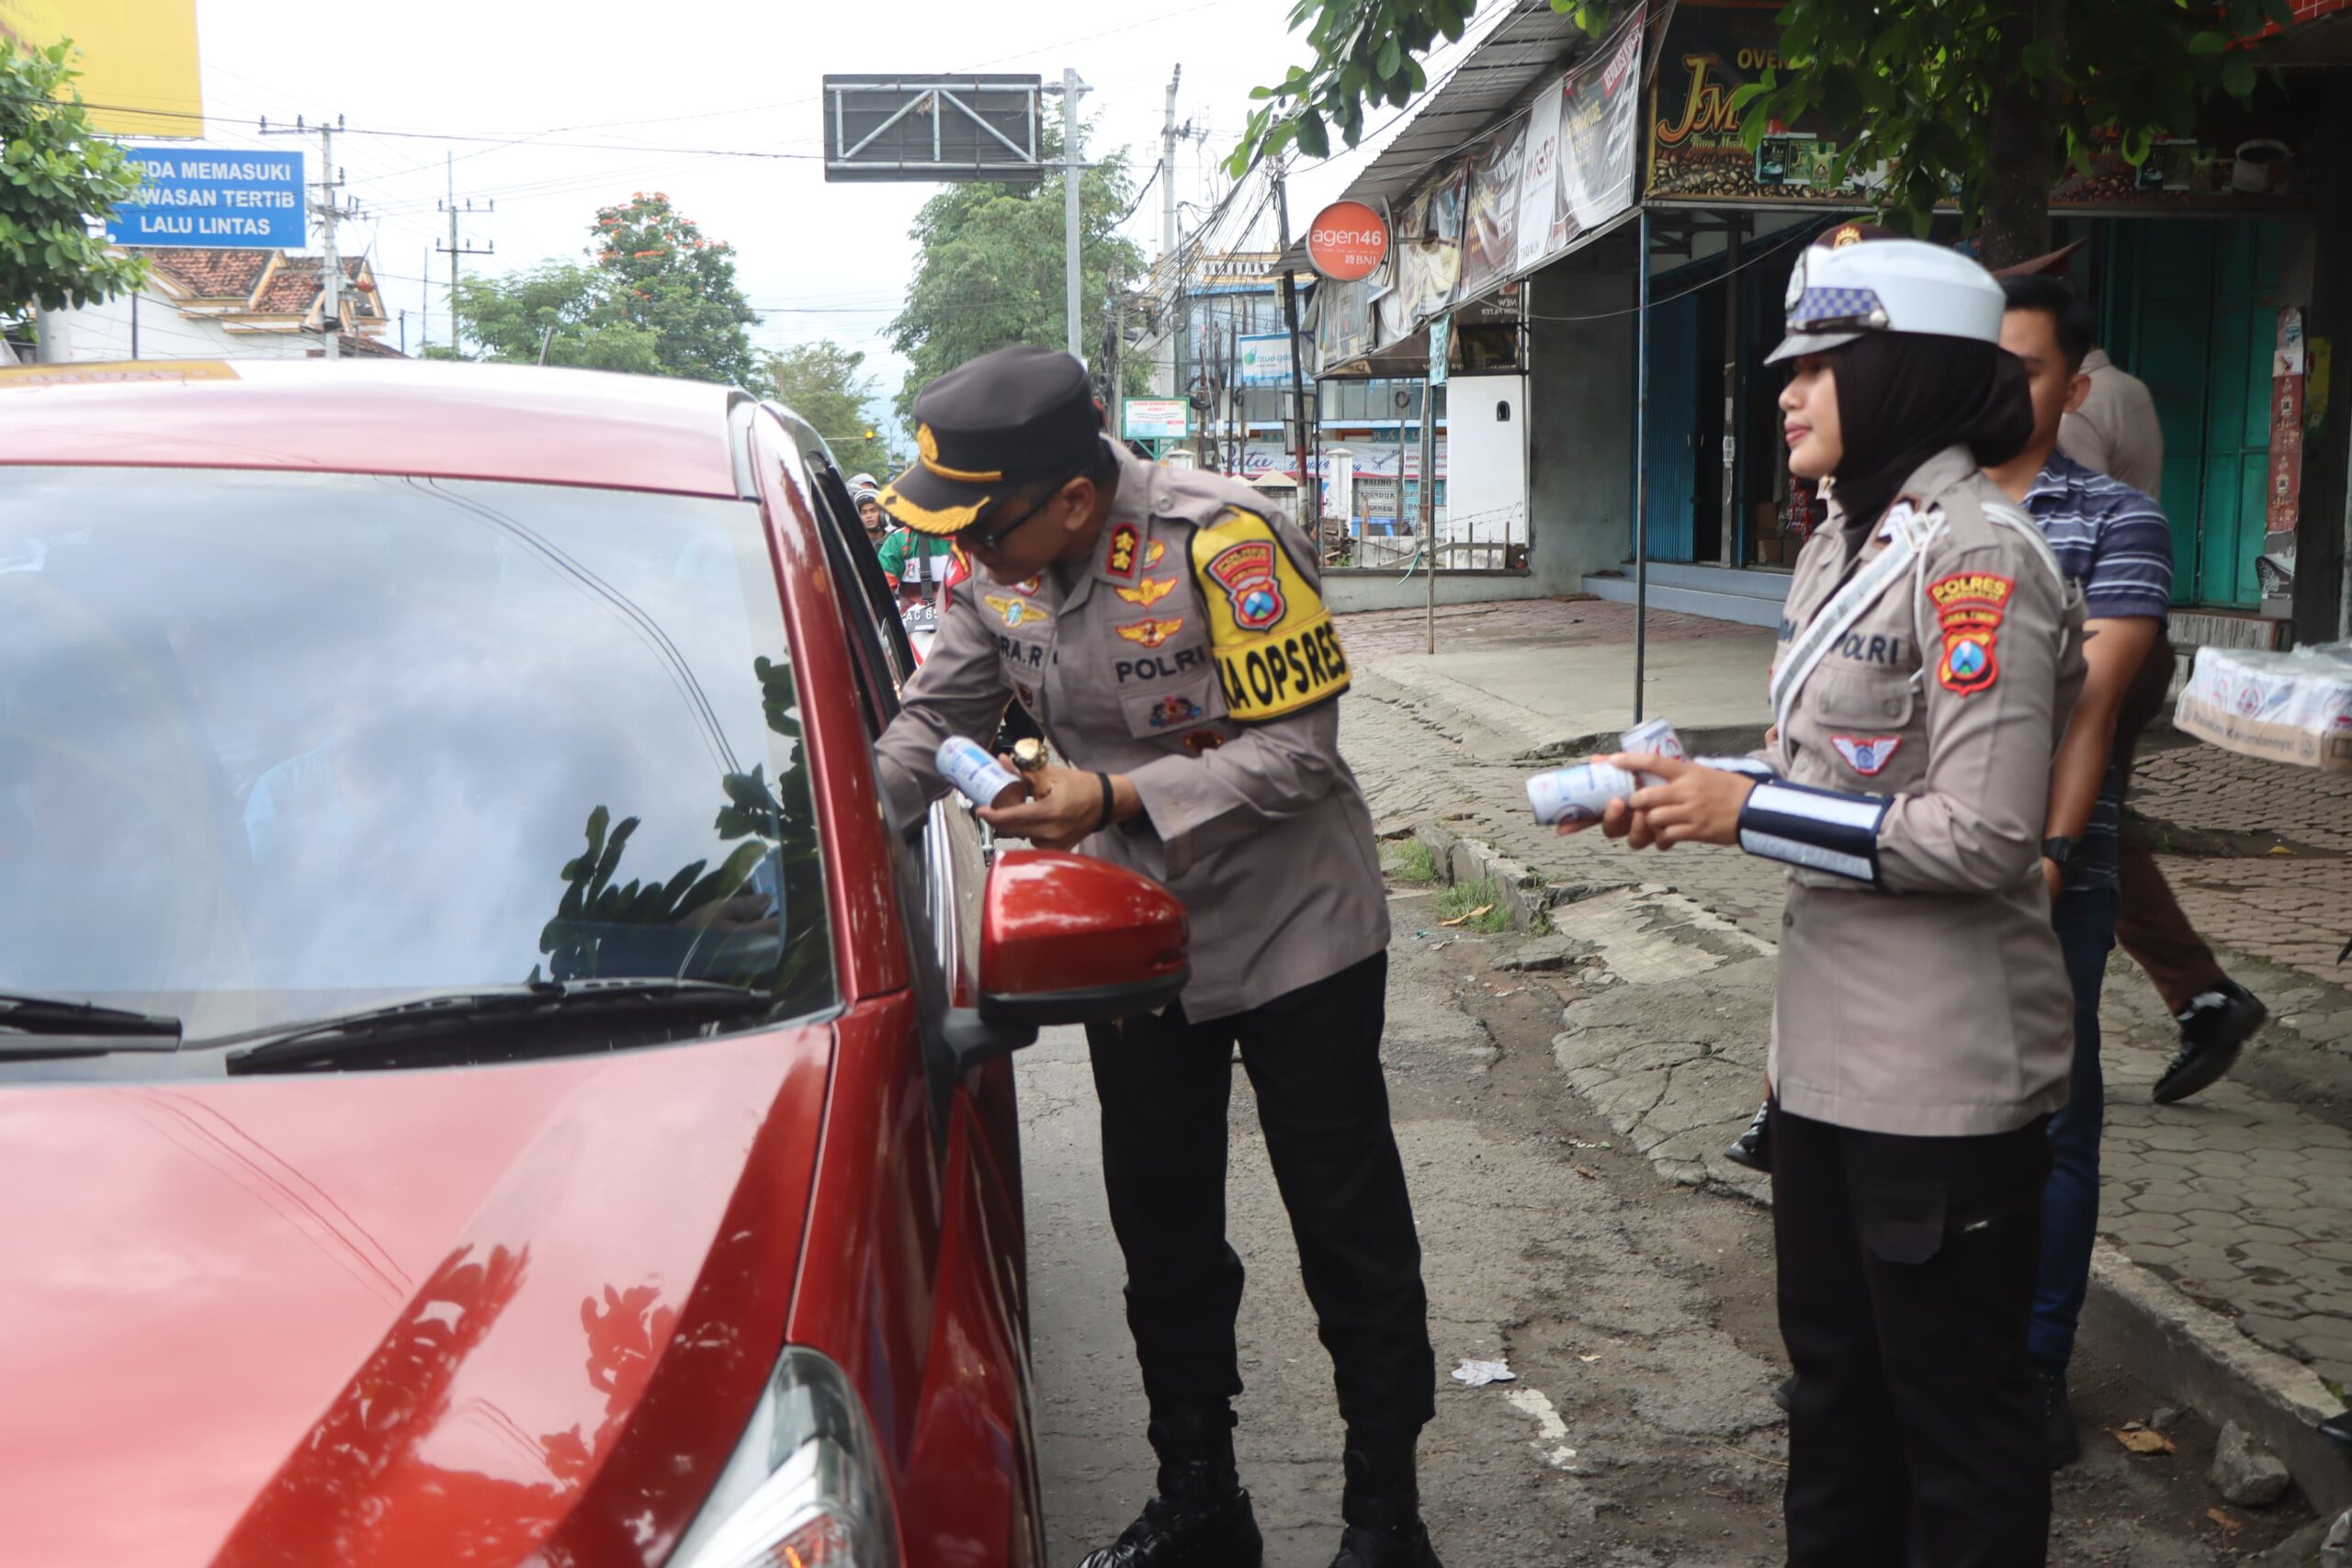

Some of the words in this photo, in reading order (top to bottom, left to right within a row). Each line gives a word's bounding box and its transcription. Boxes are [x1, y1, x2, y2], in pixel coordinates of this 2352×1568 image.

[181, 162, 291, 181] MEMASUKI
[131, 188, 217, 207] WASAN
[222, 190, 295, 208] TERTIB
[141, 216, 193, 233] LALU
[198, 218, 270, 235] LINTAS
[1312, 229, 1382, 247] agen46
[1355, 255, 1376, 265] BNI
[1372, 430, 1420, 441] RAU
[1931, 575, 2007, 601] POLRES
[1114, 646, 1206, 683] POLRI
[1246, 621, 1347, 706] OPSRES
